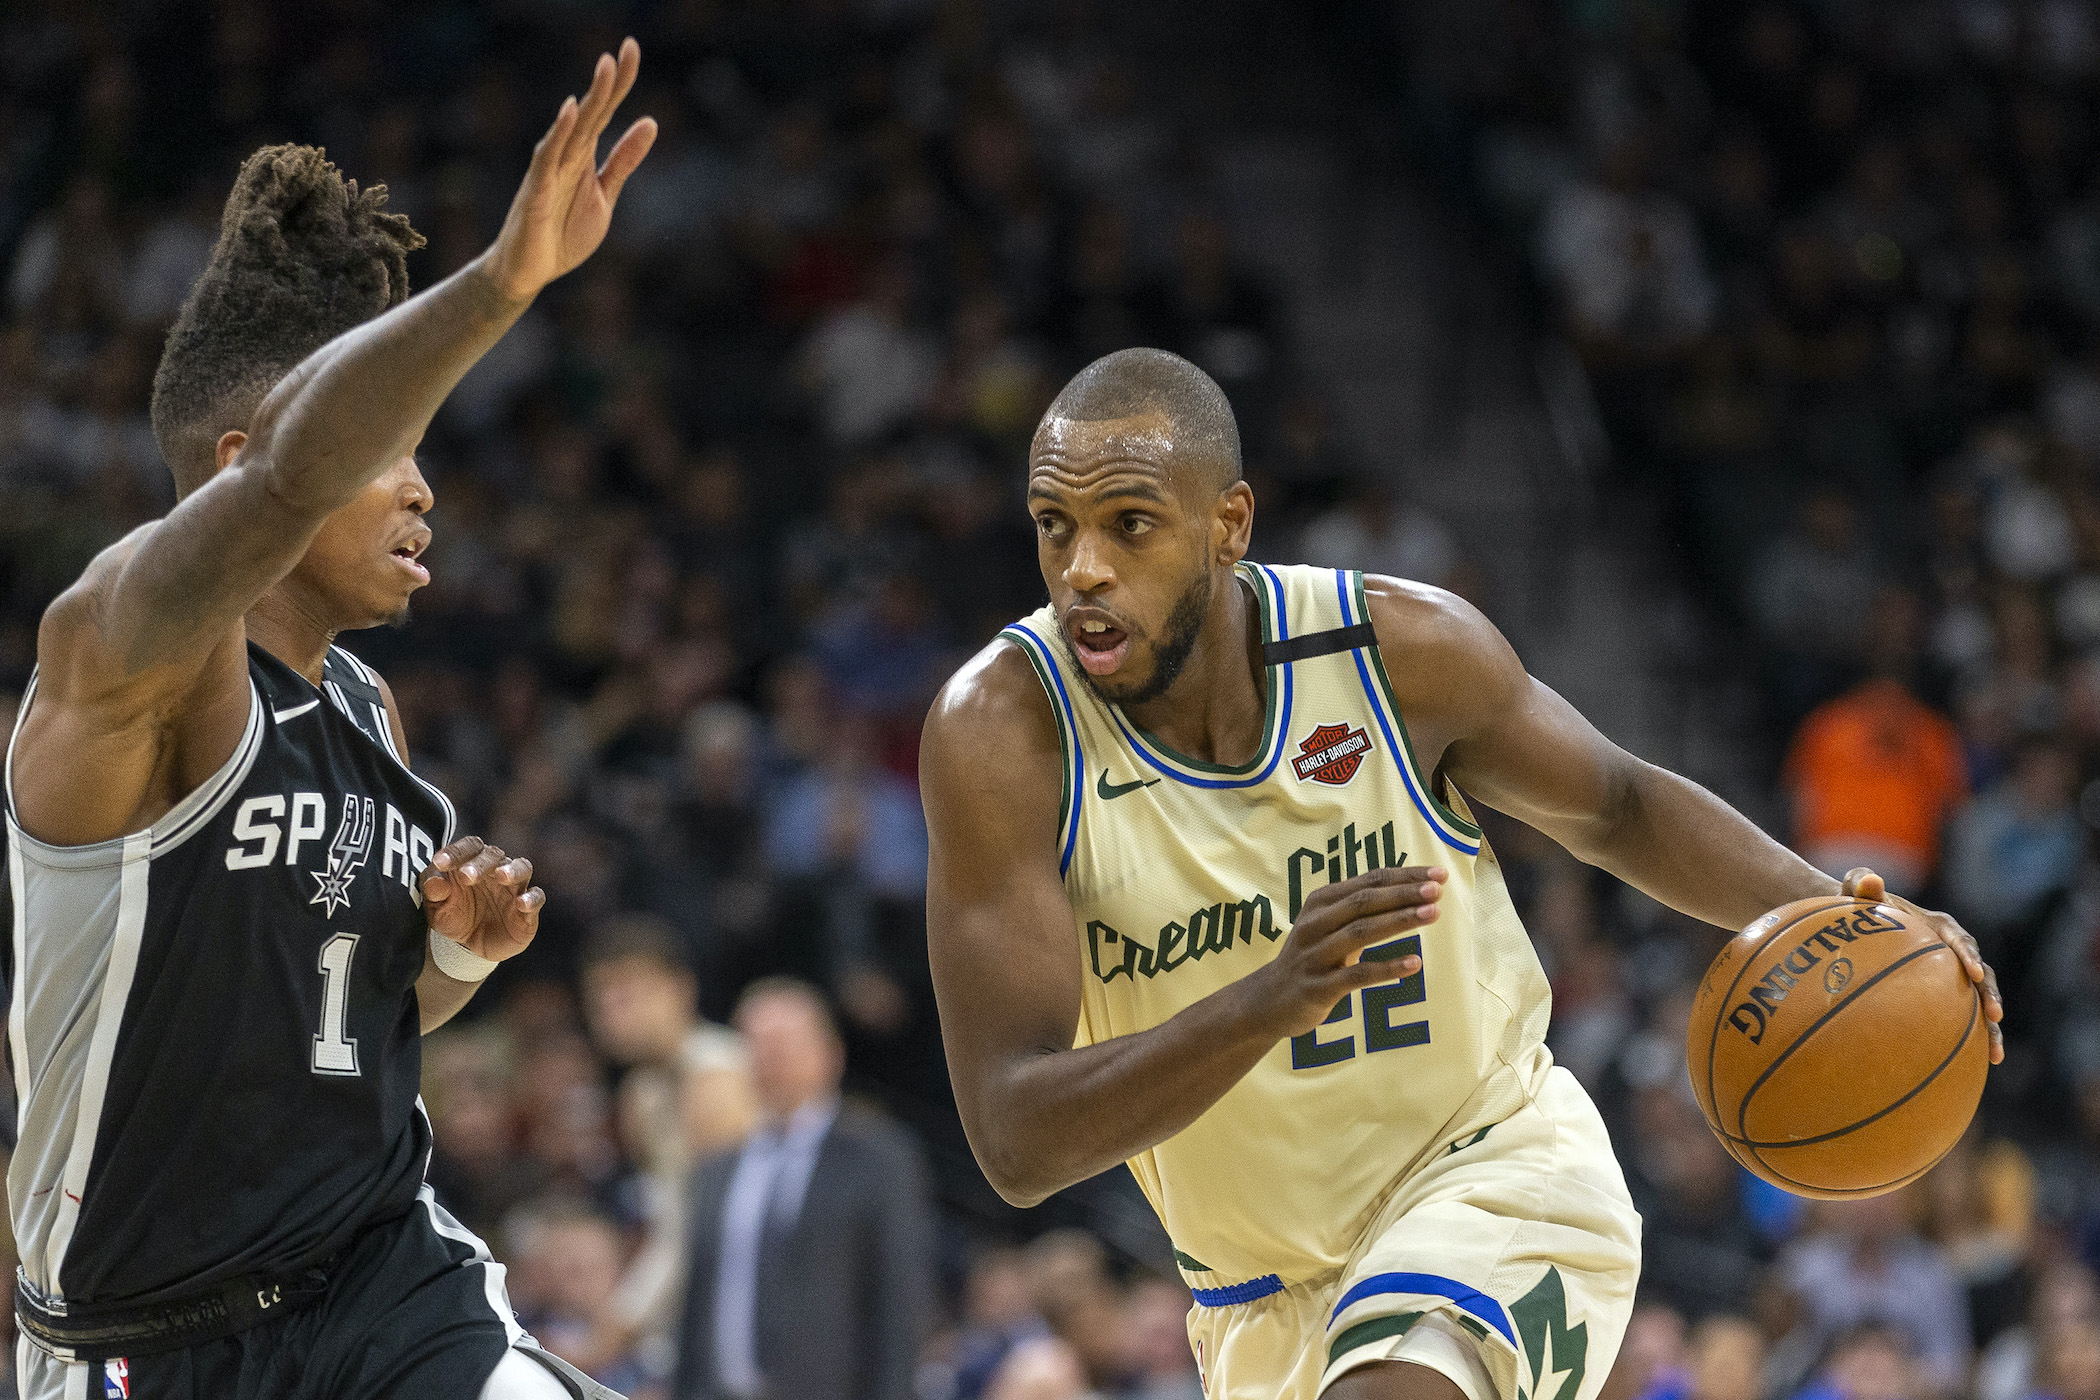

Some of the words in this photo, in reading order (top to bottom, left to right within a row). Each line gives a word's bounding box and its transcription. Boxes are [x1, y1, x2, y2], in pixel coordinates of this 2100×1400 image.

[1298, 734, 1366, 774] HARLEY-DAVIDSON
[1308, 729, 1344, 751] MOTOR
[1320, 756, 1355, 780] CYCLES
[1086, 893, 1283, 984] Cream
[311, 931, 362, 1077] 1
[1728, 905, 1906, 1046] SPALDING
